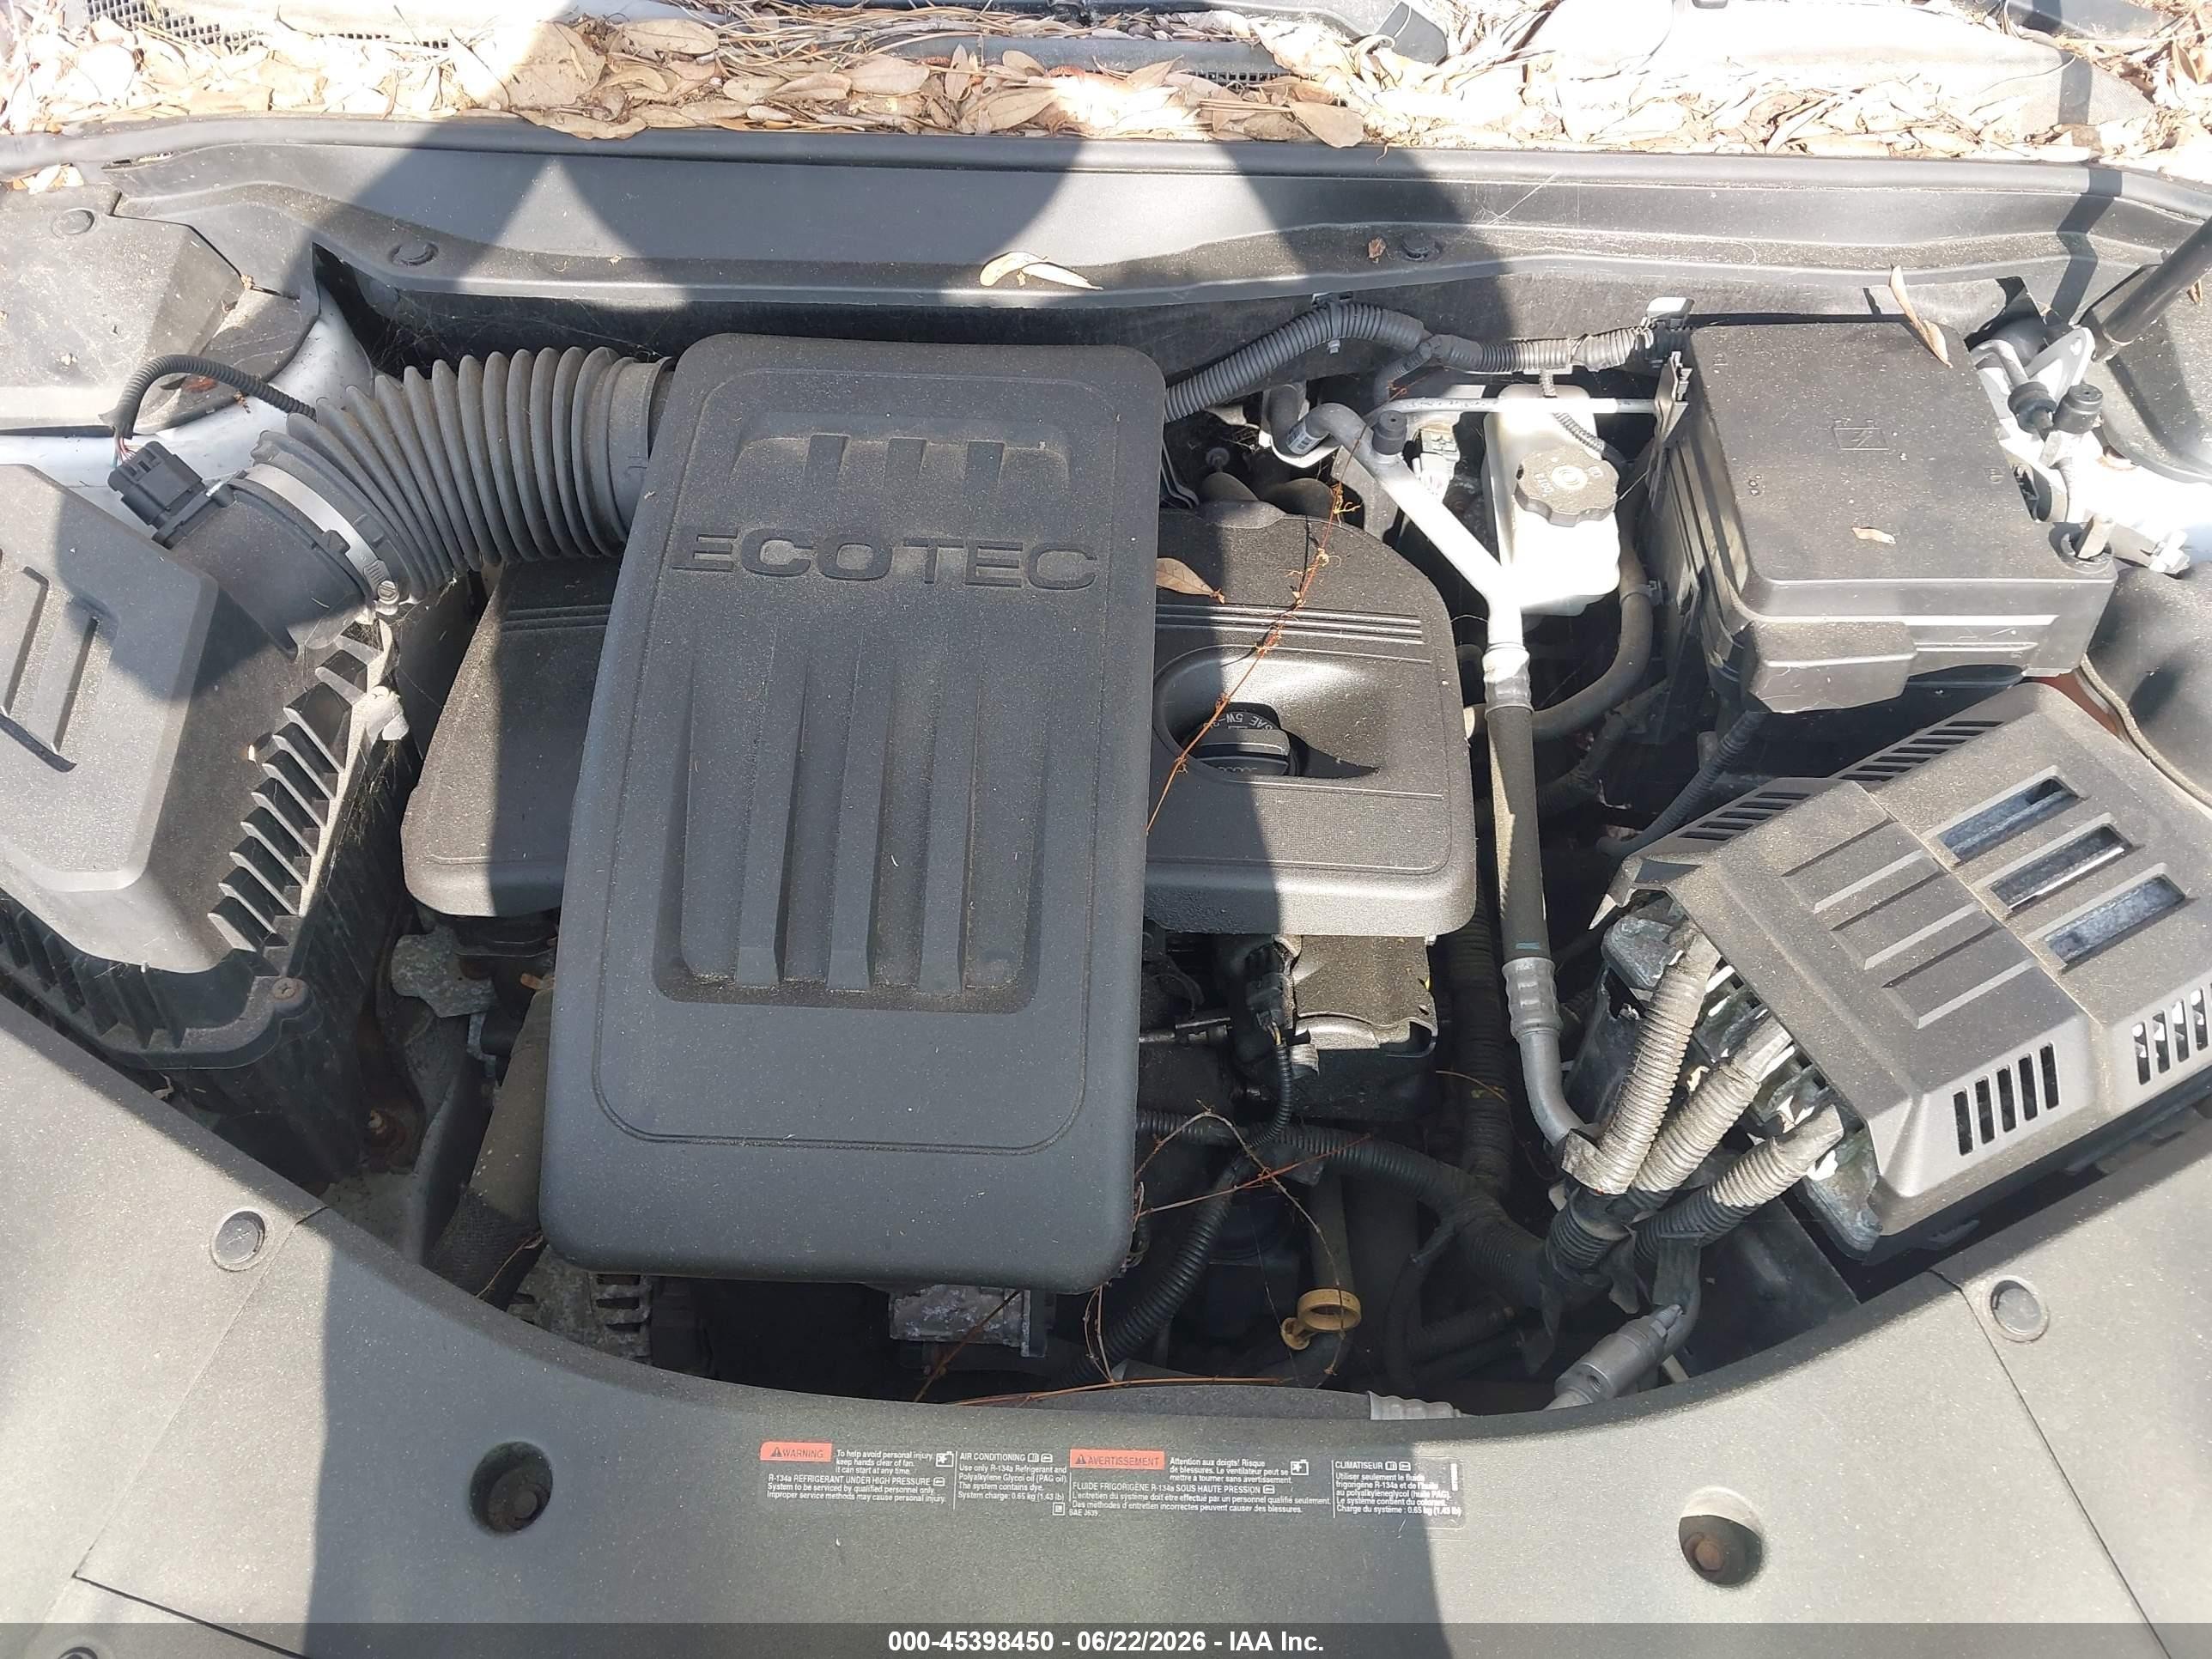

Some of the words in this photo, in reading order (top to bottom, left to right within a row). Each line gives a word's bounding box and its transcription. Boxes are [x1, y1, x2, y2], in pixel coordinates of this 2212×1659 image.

[672, 526, 1097, 590] ECOTEC
[783, 1449, 823, 1458] WARNING
[847, 1449, 861, 1459] help
[862, 1449, 882, 1458] avoid
[883, 1451, 912, 1460] personal
[960, 1452, 972, 1461] AIR
[974, 1453, 1026, 1462] CONDITIONING
[836, 1458, 853, 1468] keep
[1216, 1459, 1240, 1468] doigts!
[1335, 1462, 1383, 1470] CLIMATISEUR
[1015, 1465, 1053, 1474] Refrigerant
[769, 1474, 792, 1483] R-134a
[793, 1475, 844, 1484] REFRIGERANT
[958, 1473, 1001, 1482] Polyalkylene
[1003, 1474, 1024, 1483] Glycol
[768, 1483, 793, 1492] System
[843, 1486, 853, 1494] by
[854, 1486, 883, 1494] qualified
[884, 1486, 918, 1495] personnel
[1030, 1484, 1044, 1492] dye.
[1073, 1482, 1098, 1491] FLUIDE
[1197, 1485, 1222, 1493] HAUTE
[768, 1491, 799, 1500] Improper
[958, 1491, 982, 1500] System
[985, 1492, 1010, 1501] charge:
[1027, 1492, 1036, 1501] kg
[1037, 1493, 1054, 1502] (1.43
[1121, 1501, 1158, 1510] d'entretien
[1337, 1505, 1361, 1514] Charge
